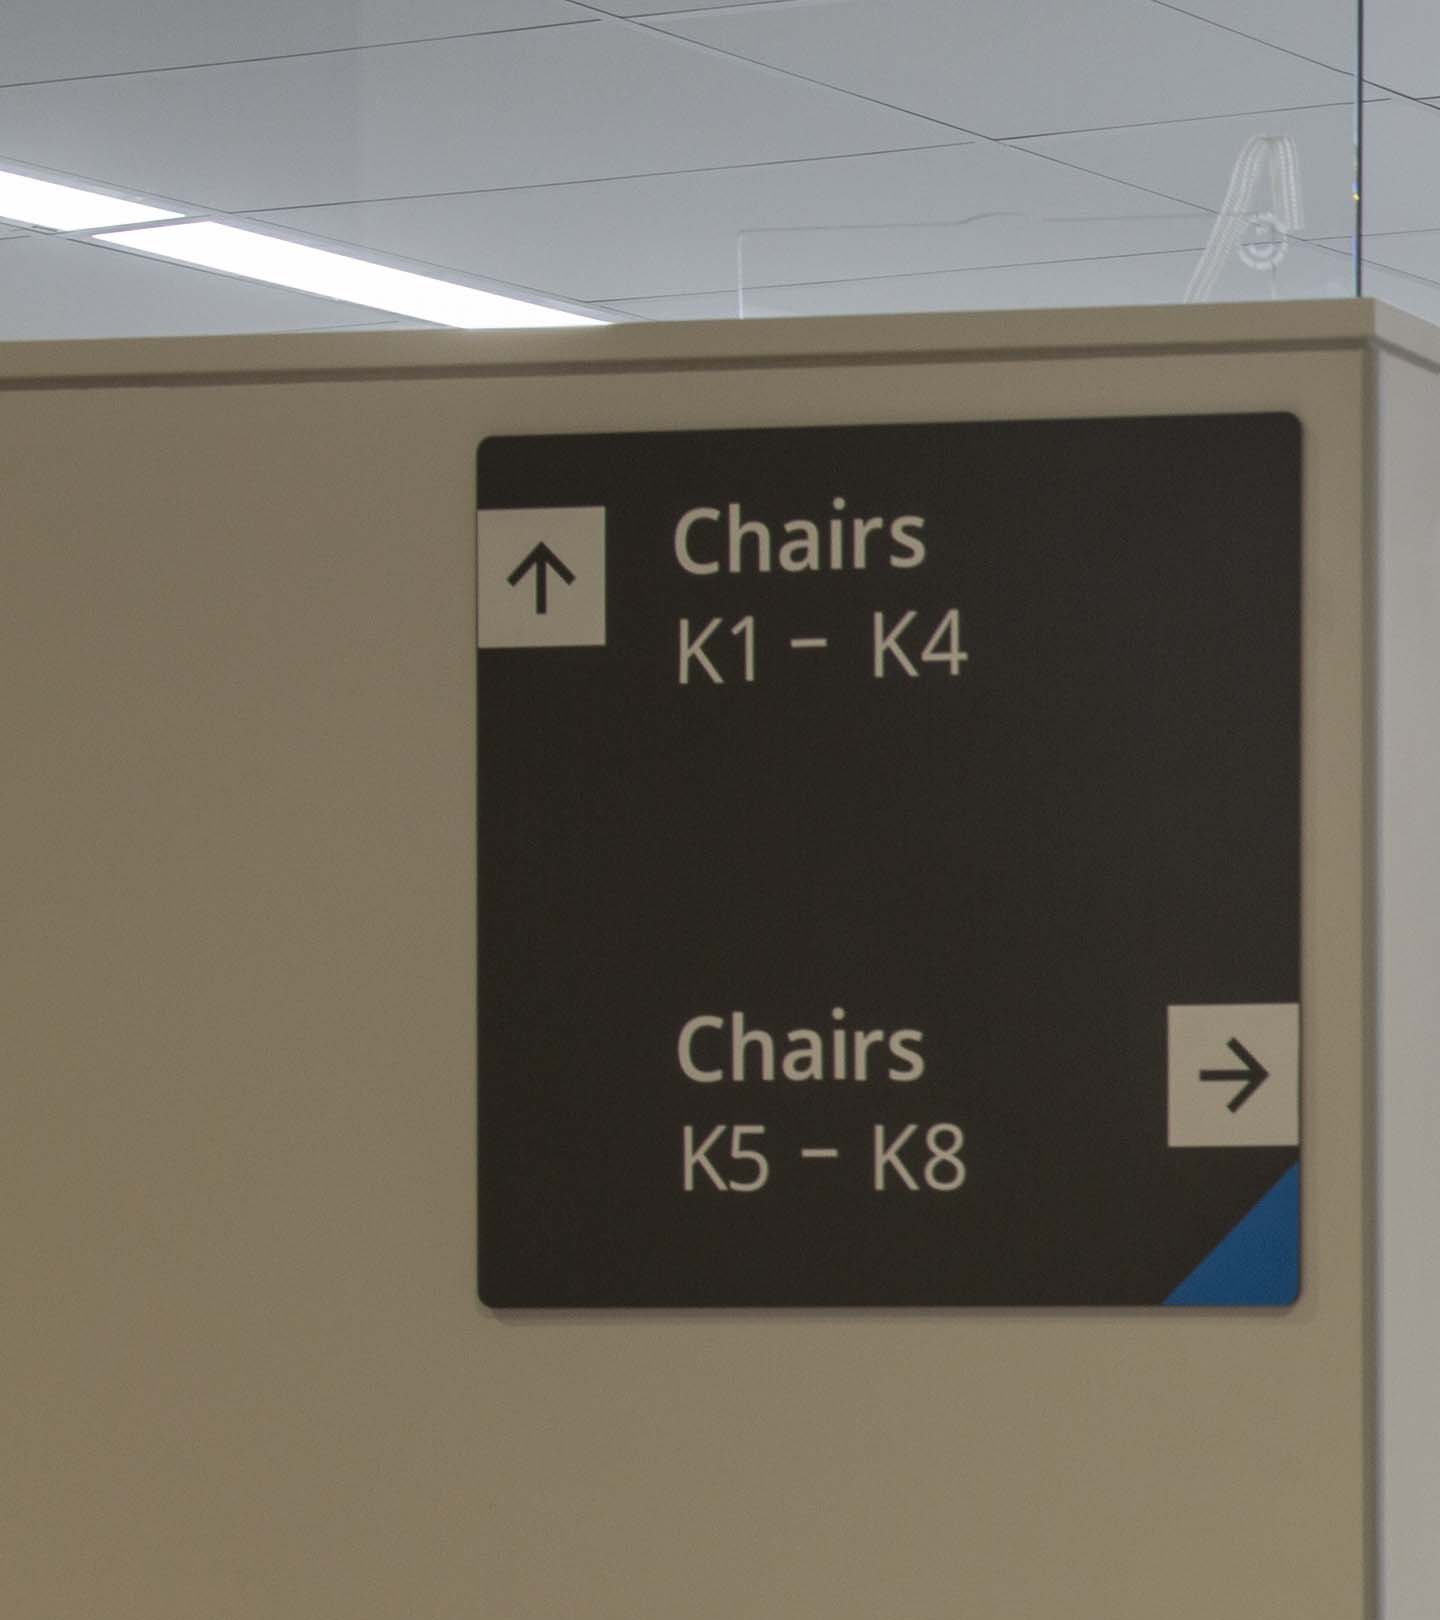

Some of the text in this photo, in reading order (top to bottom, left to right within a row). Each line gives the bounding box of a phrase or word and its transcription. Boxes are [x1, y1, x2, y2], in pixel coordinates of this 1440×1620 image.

[674, 497, 926, 575] Chairs
[679, 615, 755, 685] K1
[873, 608, 969, 678] K4
[677, 1007, 925, 1083] Chairs
[683, 1123, 769, 1192] K5
[874, 1122, 966, 1191] K8
